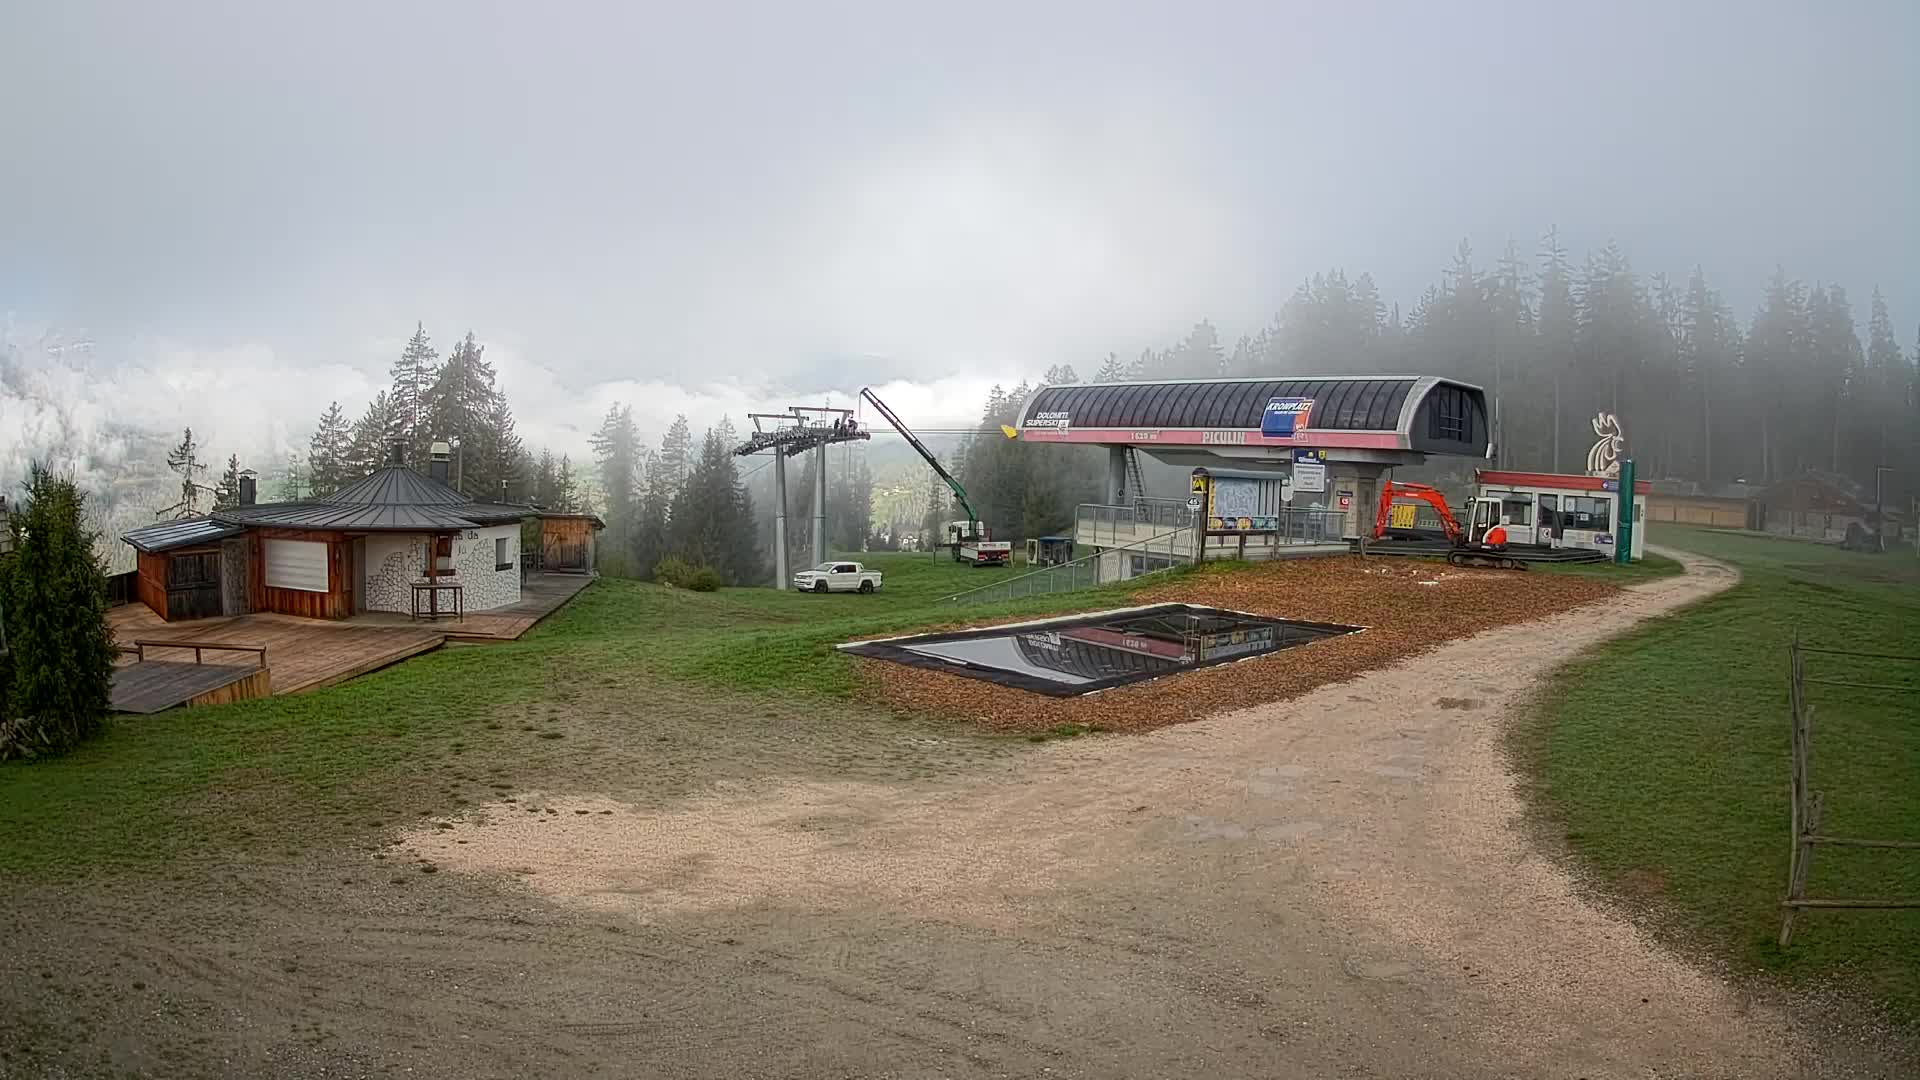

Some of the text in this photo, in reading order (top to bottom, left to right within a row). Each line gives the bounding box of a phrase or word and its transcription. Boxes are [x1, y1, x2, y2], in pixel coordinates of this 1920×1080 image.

[1267, 402, 1312, 411] KRONPLATZ
[1036, 411, 1069, 419] DOLOMITI
[1026, 419, 1058, 427] SUPERSKI
[1202, 431, 1246, 444] PICULIN
